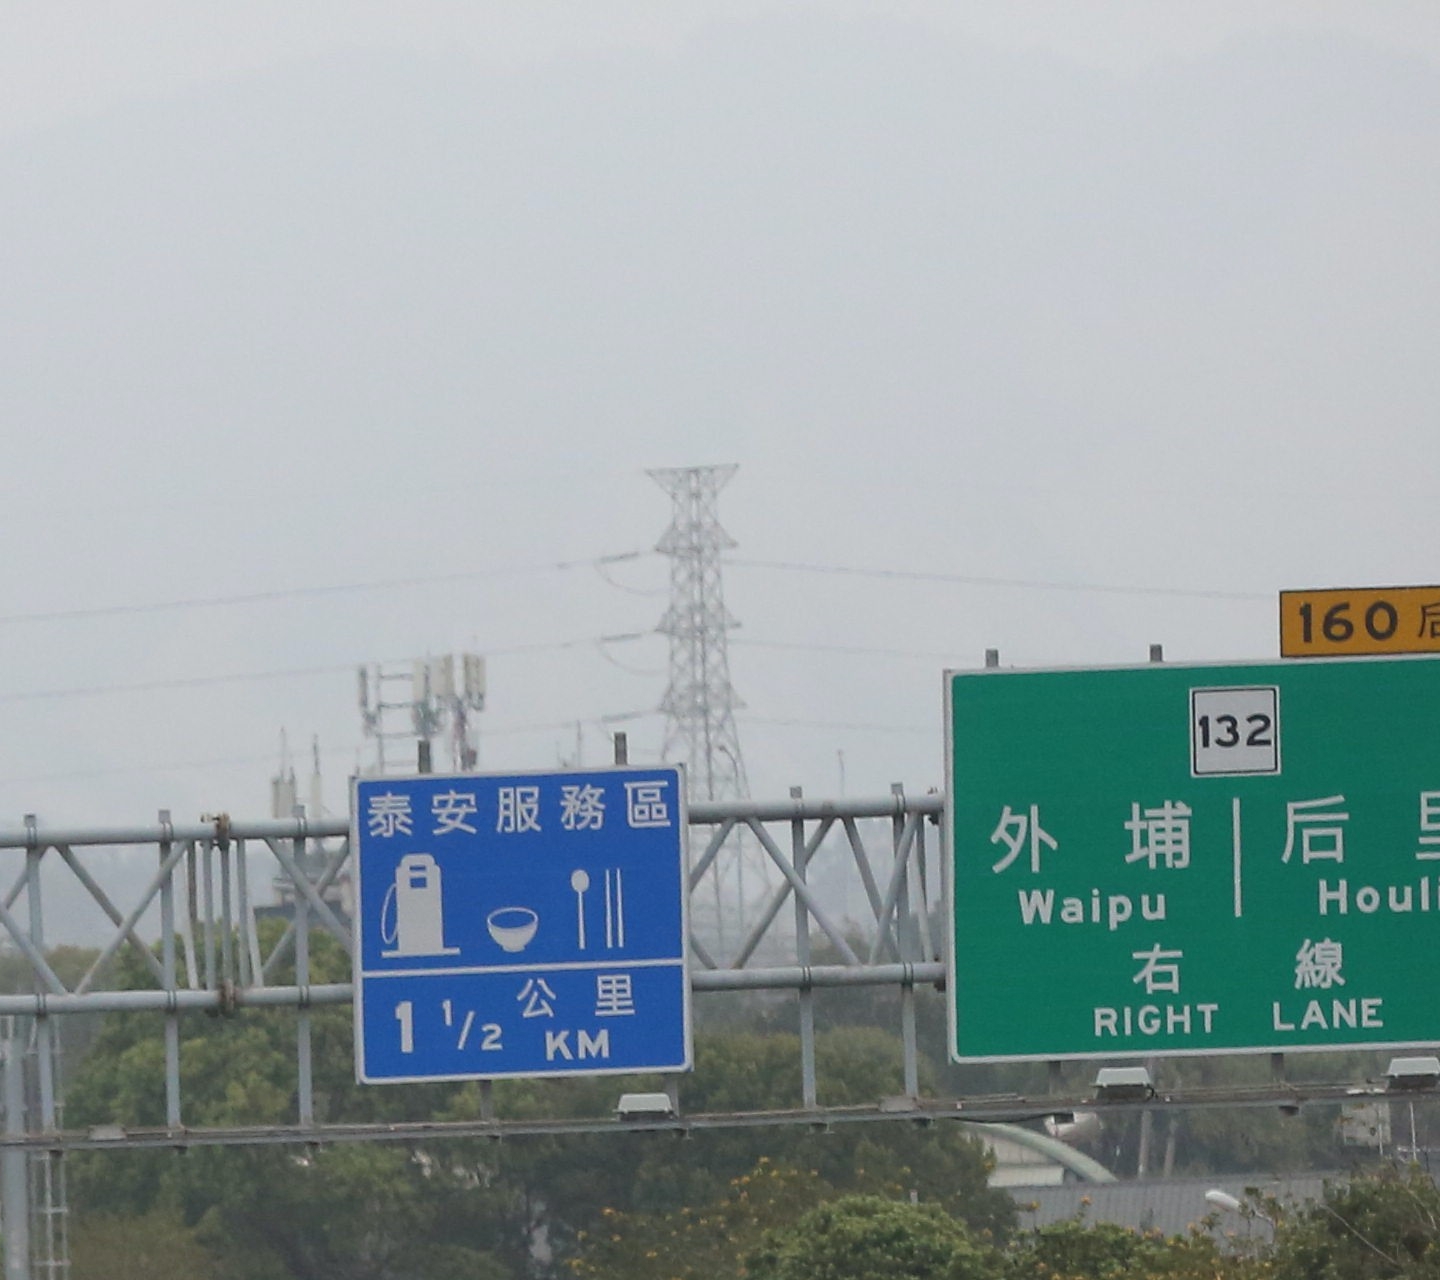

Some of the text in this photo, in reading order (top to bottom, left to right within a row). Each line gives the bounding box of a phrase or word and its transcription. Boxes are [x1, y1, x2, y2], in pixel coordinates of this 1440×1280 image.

[1298, 601, 1398, 643] 160
[1198, 713, 1273, 749] 132
[367, 780, 671, 839] 泰安服務區
[990, 800, 1192, 874] 外埔
[1018, 889, 1167, 931] Waipu
[1132, 938, 1346, 994] 右線
[517, 974, 636, 1019] 公里
[1094, 998, 1384, 1037] RIGHT LANE
[546, 1029, 610, 1061] KM
